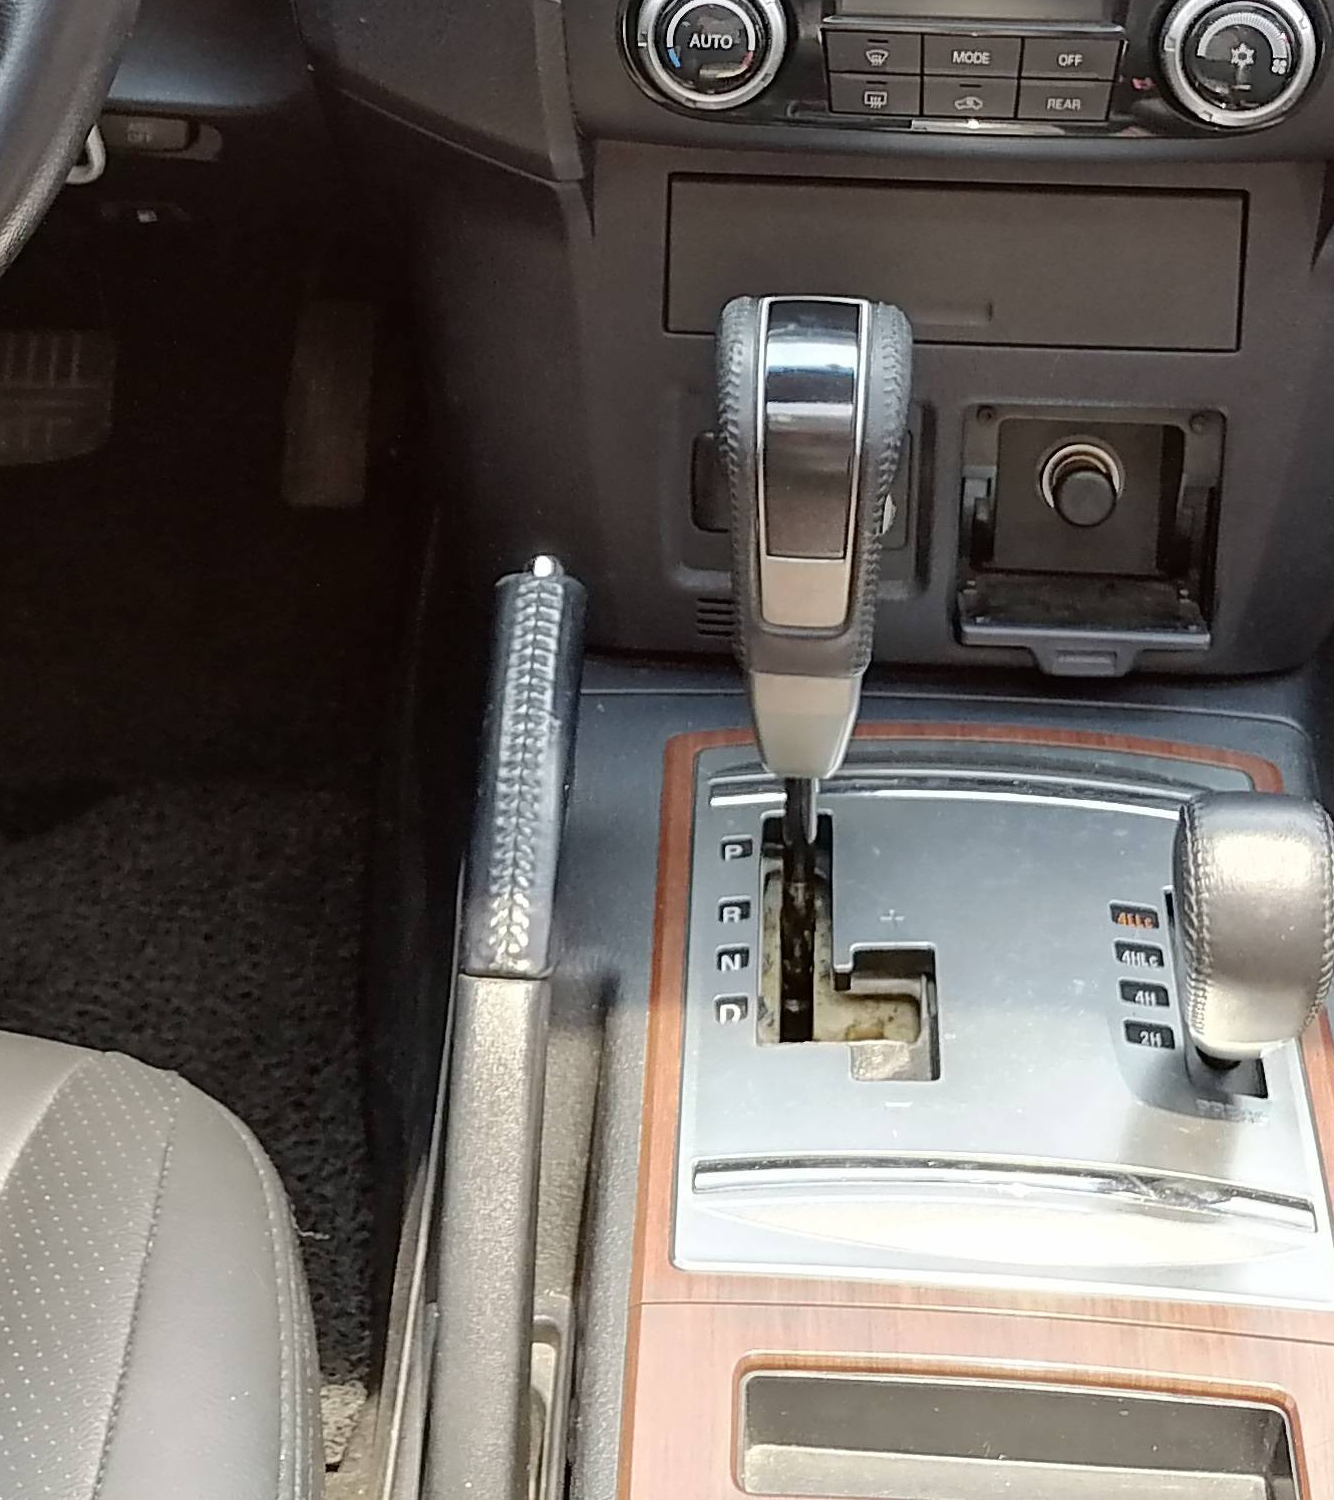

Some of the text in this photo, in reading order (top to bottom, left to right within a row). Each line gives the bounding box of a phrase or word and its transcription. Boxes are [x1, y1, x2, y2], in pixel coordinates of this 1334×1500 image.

[689, 33, 733, 49] AUTO
[953, 50, 990, 65] MODE
[1058, 53, 1083, 67] OFF
[1046, 97, 1081, 111] REAR
[724, 844, 744, 861] P
[722, 906, 742, 924] R
[720, 955, 742, 972] N
[1134, 990, 1157, 1006] 4H
[719, 1004, 742, 1025] D
[1139, 1031, 1162, 1047] 2H
